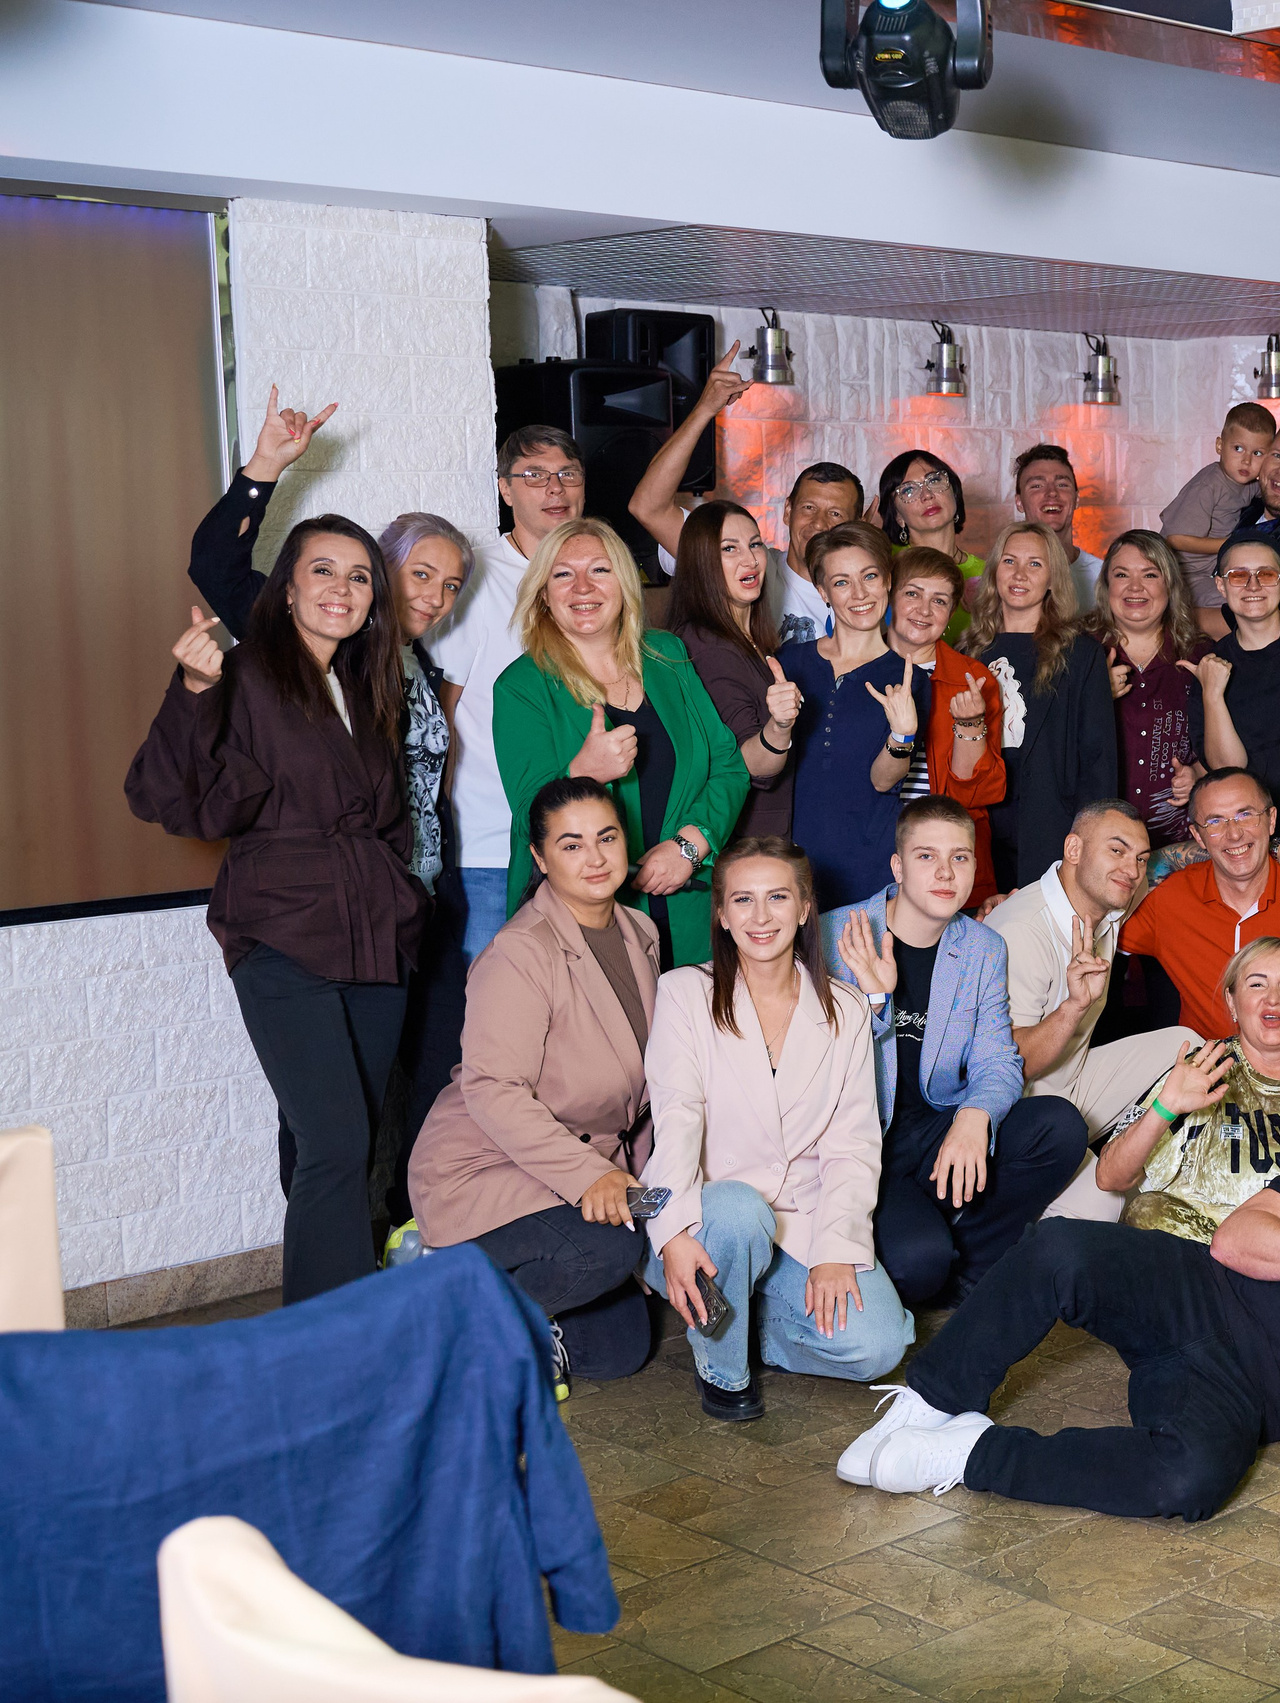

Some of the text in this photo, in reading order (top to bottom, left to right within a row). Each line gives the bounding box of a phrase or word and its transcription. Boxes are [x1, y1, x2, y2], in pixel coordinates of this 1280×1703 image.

[1149, 699, 1163, 782] IS FANTASTIC
[1163, 710, 1172, 736] very
